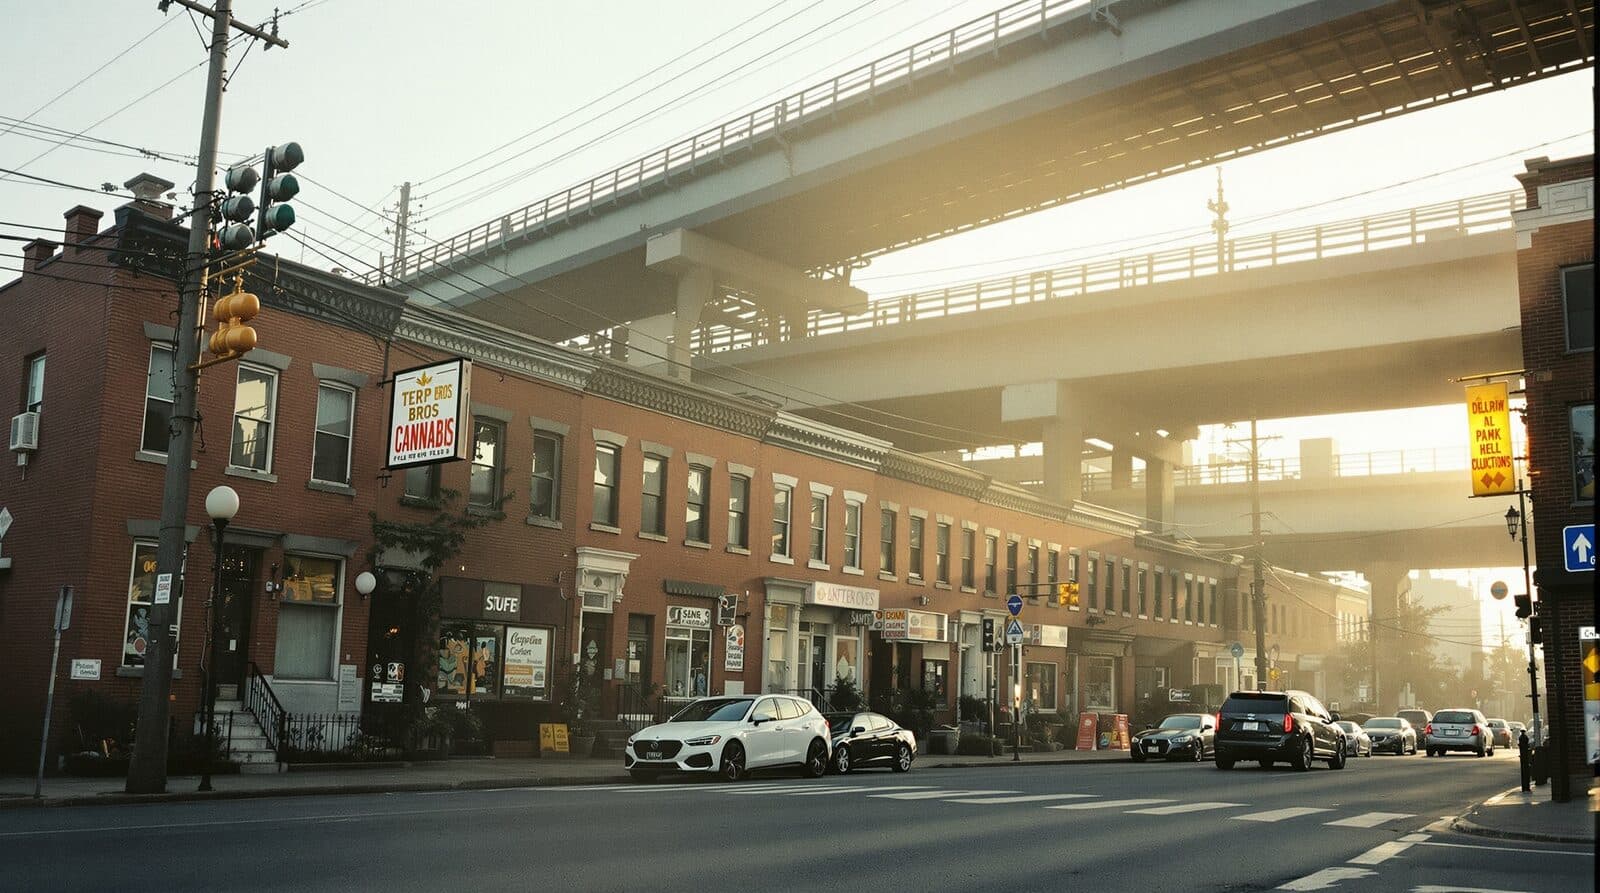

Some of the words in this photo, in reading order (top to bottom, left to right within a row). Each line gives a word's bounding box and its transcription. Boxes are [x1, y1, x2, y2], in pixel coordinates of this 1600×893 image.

[402, 388, 431, 406] TERP
[408, 403, 439, 421] BROS
[1483, 416, 1495, 427] AL
[394, 417, 454, 453] CANNABIS
